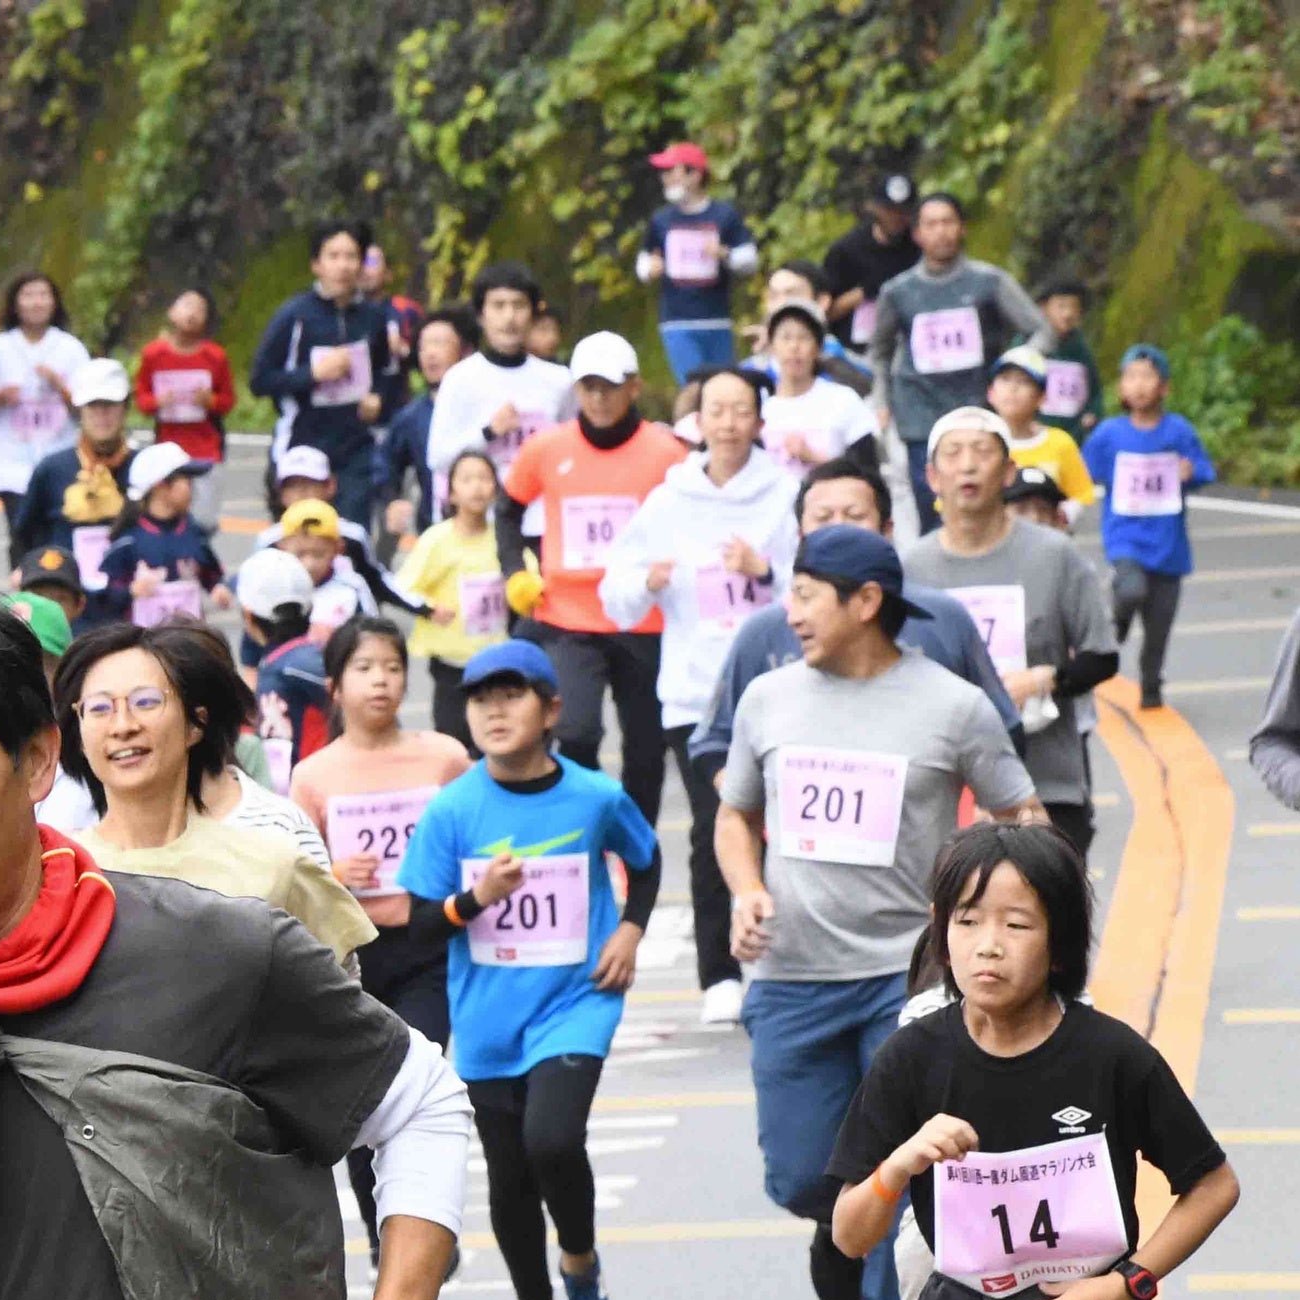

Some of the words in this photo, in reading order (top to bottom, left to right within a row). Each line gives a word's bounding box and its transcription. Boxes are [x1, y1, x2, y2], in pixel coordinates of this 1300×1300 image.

[800, 783, 864, 825] 201
[495, 892, 558, 931] 201
[990, 1198, 1060, 1255] 14
